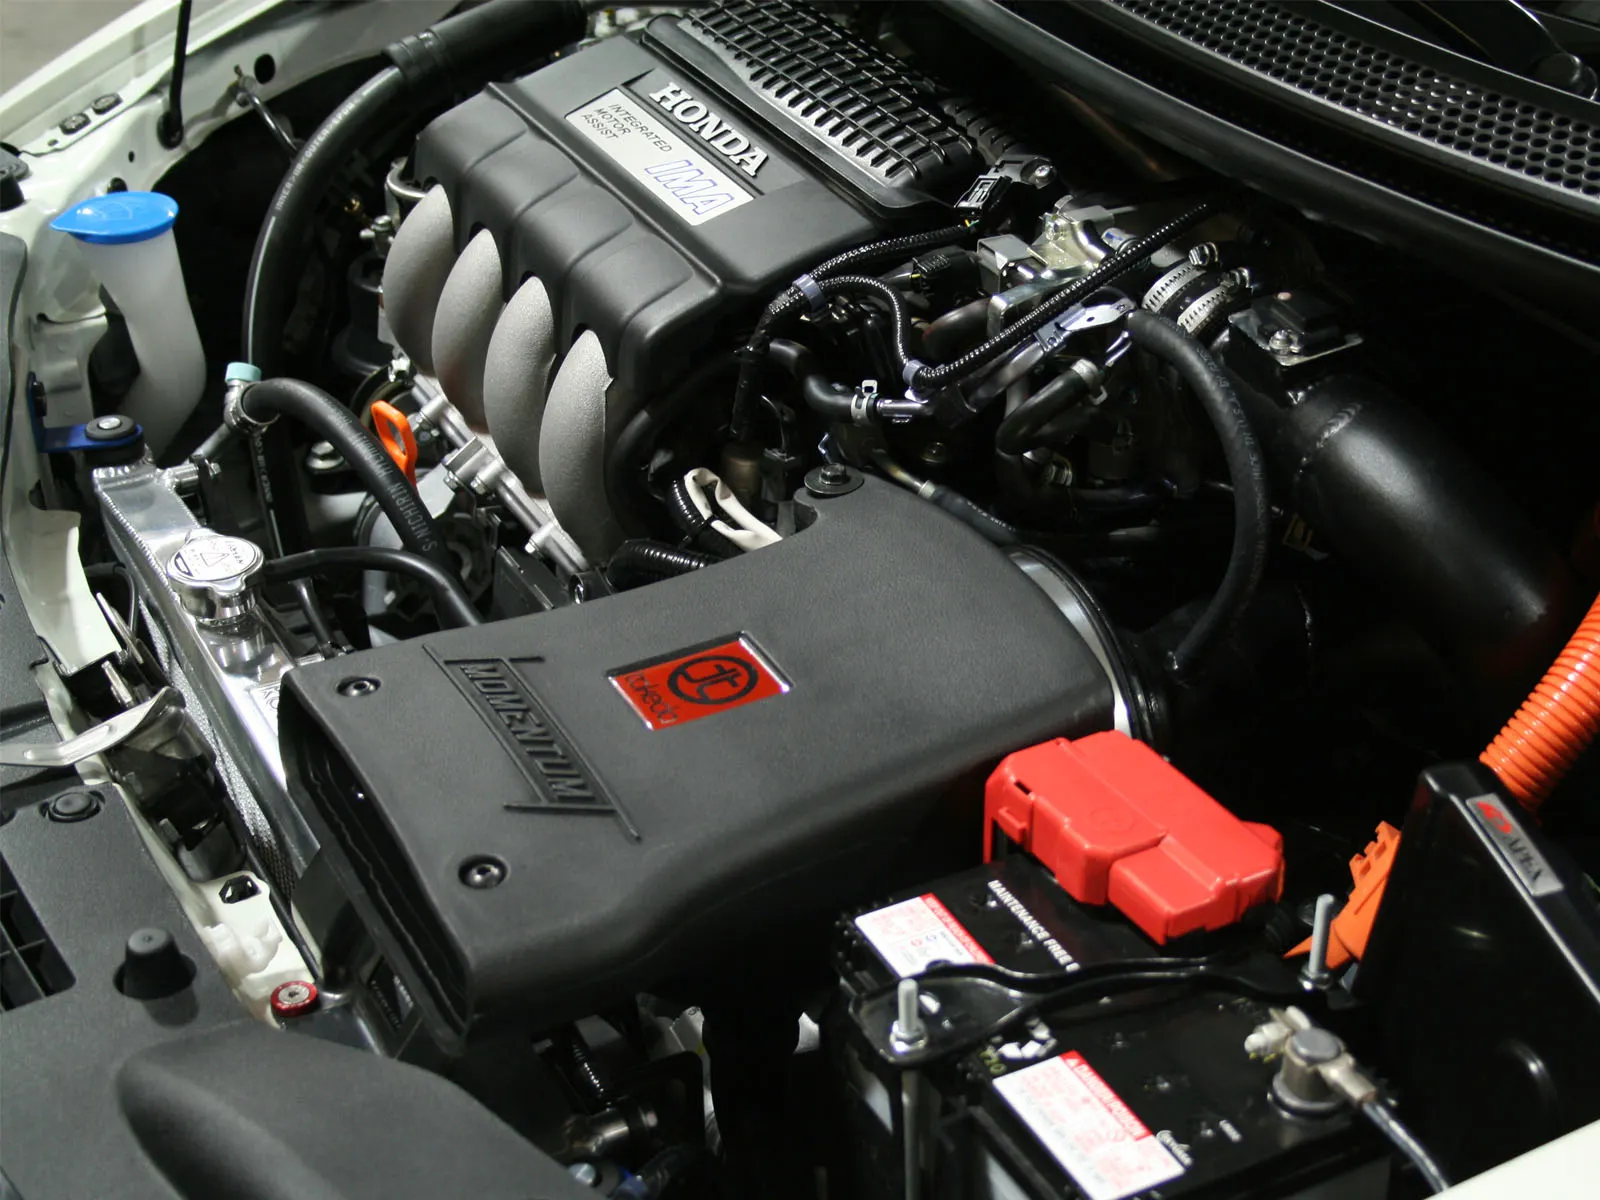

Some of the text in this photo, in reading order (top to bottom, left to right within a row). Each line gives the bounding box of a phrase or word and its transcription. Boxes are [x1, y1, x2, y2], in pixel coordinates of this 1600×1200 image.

[581, 114, 619, 141] ASSIST
[594, 108, 631, 135] MOTOR
[608, 104, 672, 153] INTEGRATED
[649, 82, 768, 178] HONDA
[644, 159, 735, 215] IMA
[458, 662, 597, 801] MOMENTUM
[987, 880, 1073, 966] MAINTENANCE FREE
